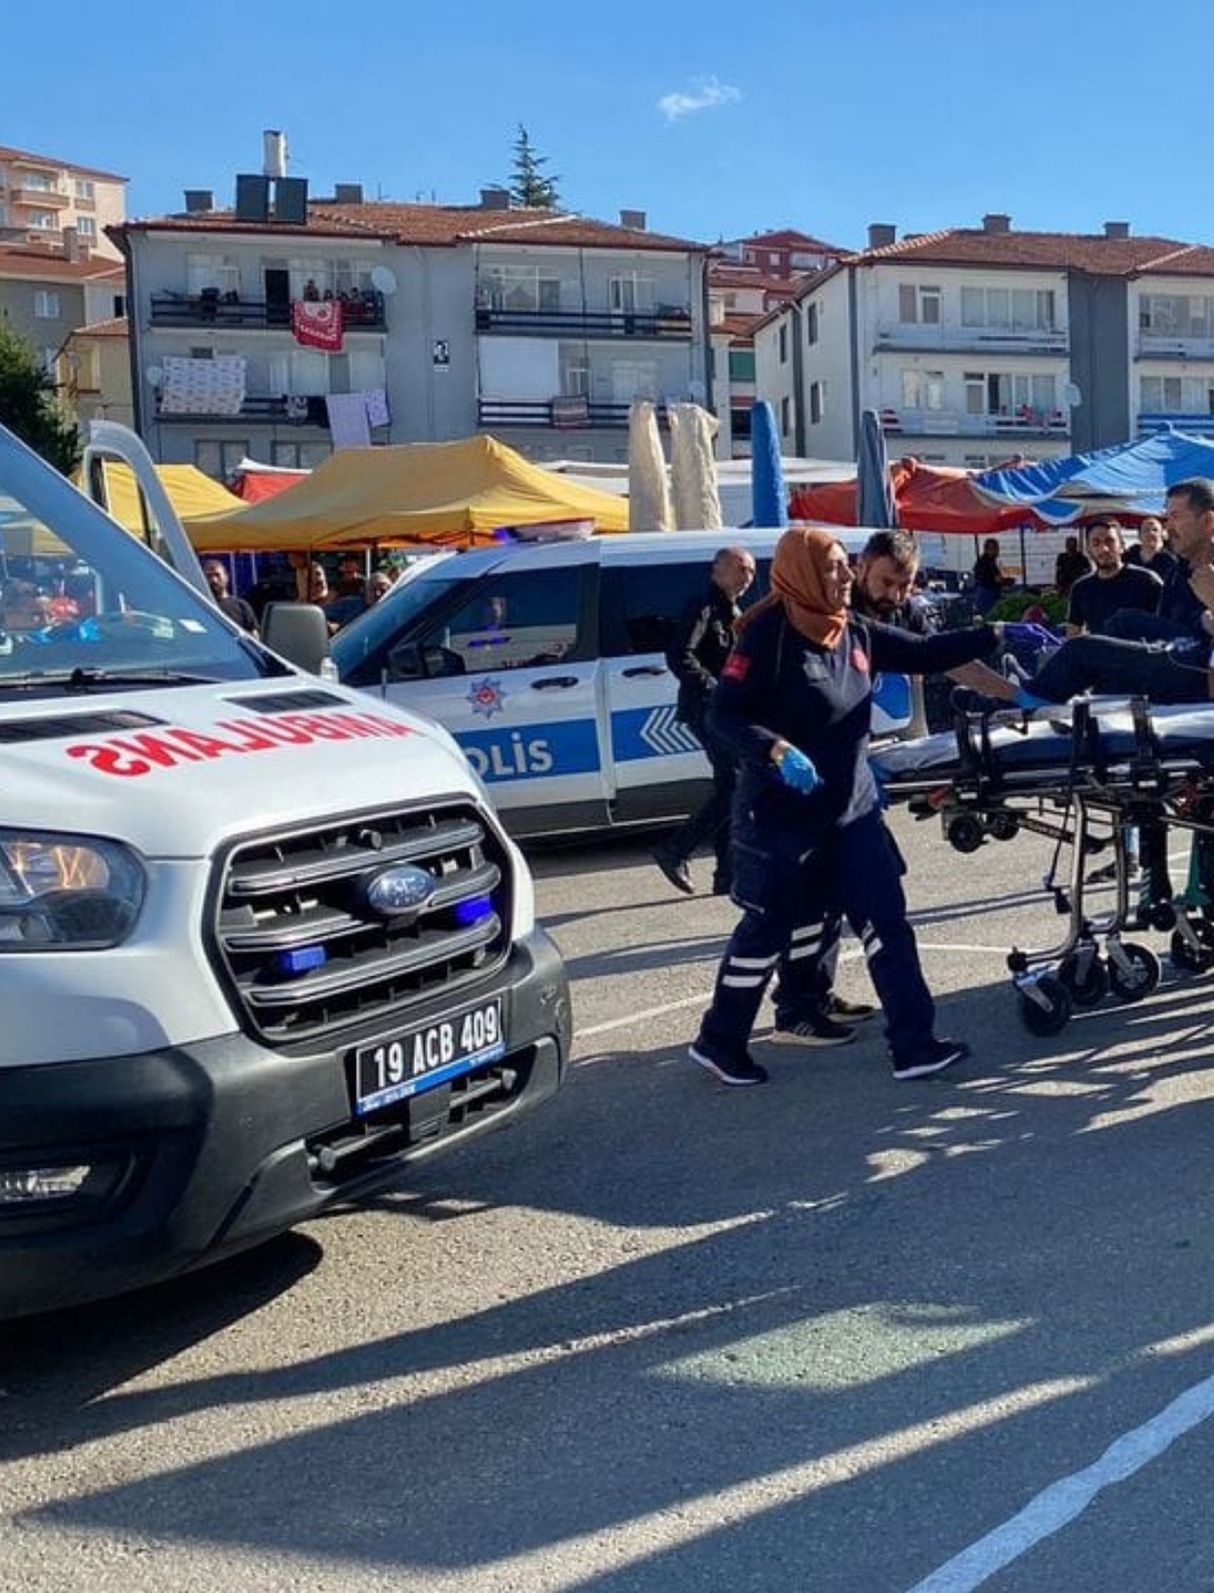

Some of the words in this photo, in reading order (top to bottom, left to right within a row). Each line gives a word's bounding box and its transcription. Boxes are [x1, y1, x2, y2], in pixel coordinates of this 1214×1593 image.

[463, 732, 553, 777] OLİS
[374, 1042, 403, 1088] 19
[413, 1023, 454, 1075] ACB
[461, 1006, 498, 1052] 409
